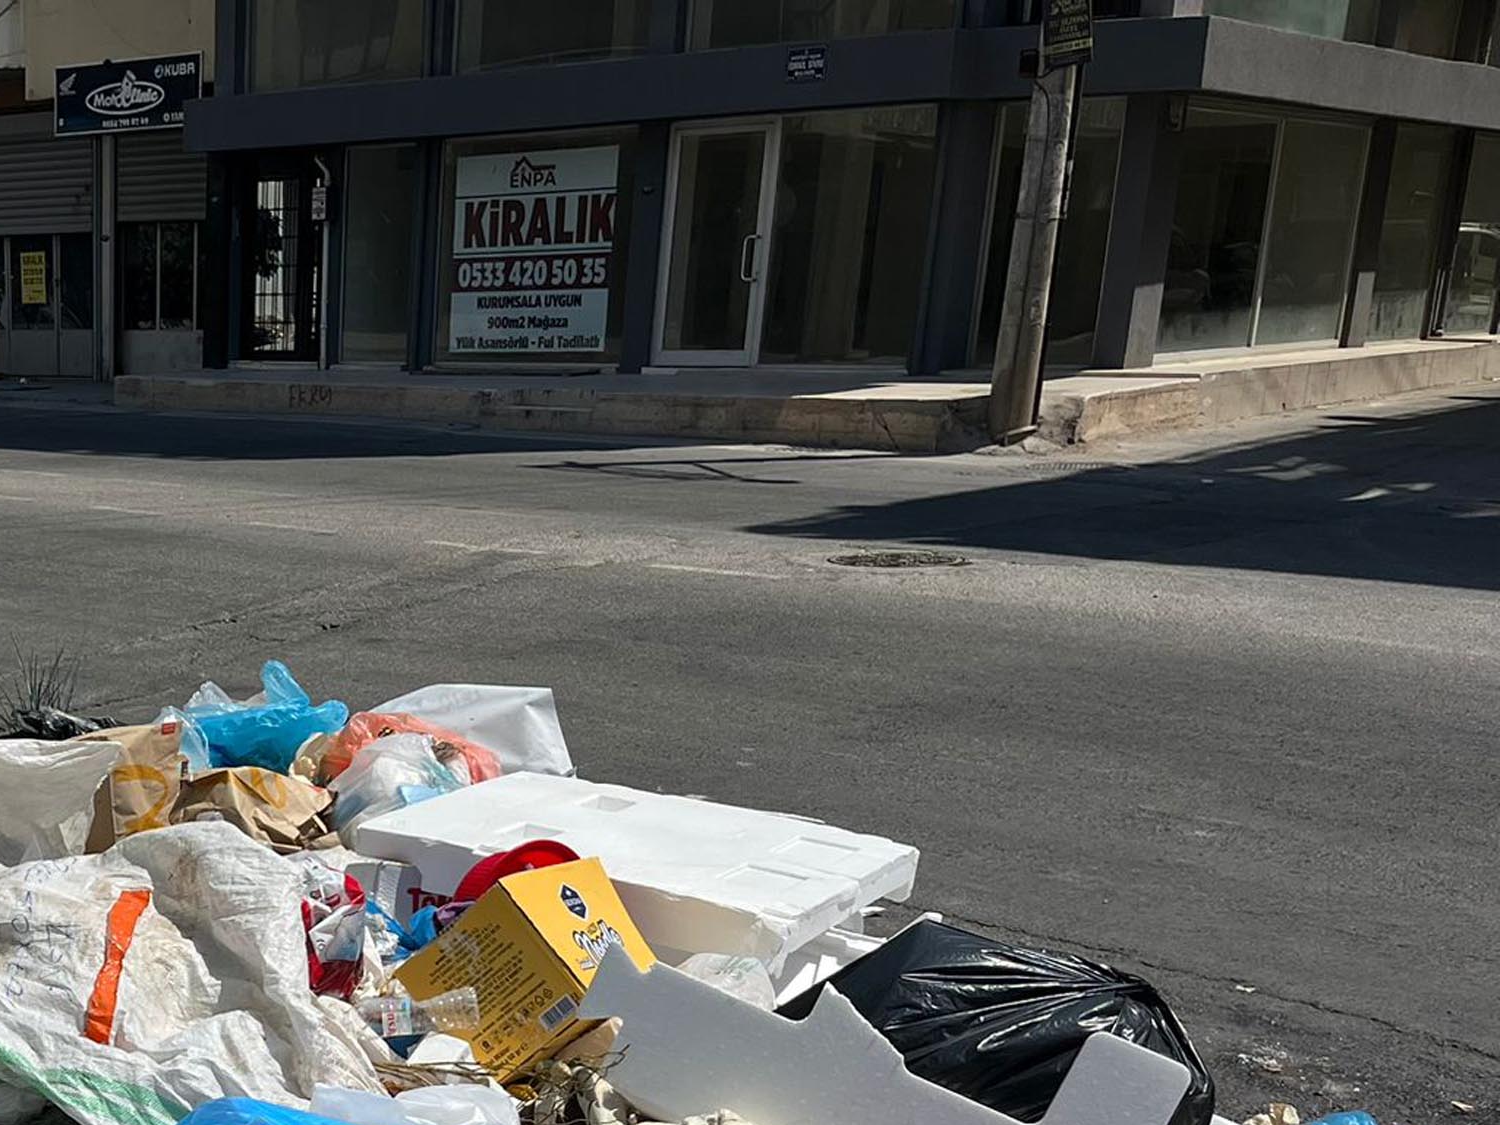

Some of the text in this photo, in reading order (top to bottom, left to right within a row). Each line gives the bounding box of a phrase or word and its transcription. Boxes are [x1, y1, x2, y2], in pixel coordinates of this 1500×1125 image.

[164, 62, 195, 77] KUBA
[510, 171, 557, 188] ENPA
[457, 258, 606, 288] 0533 420 50 35
[476, 294, 582, 310] KURUMSALA UYGUN
[487, 316, 568, 331] 900m2 Mağaza
[476, 335, 529, 349] Asansörlü
